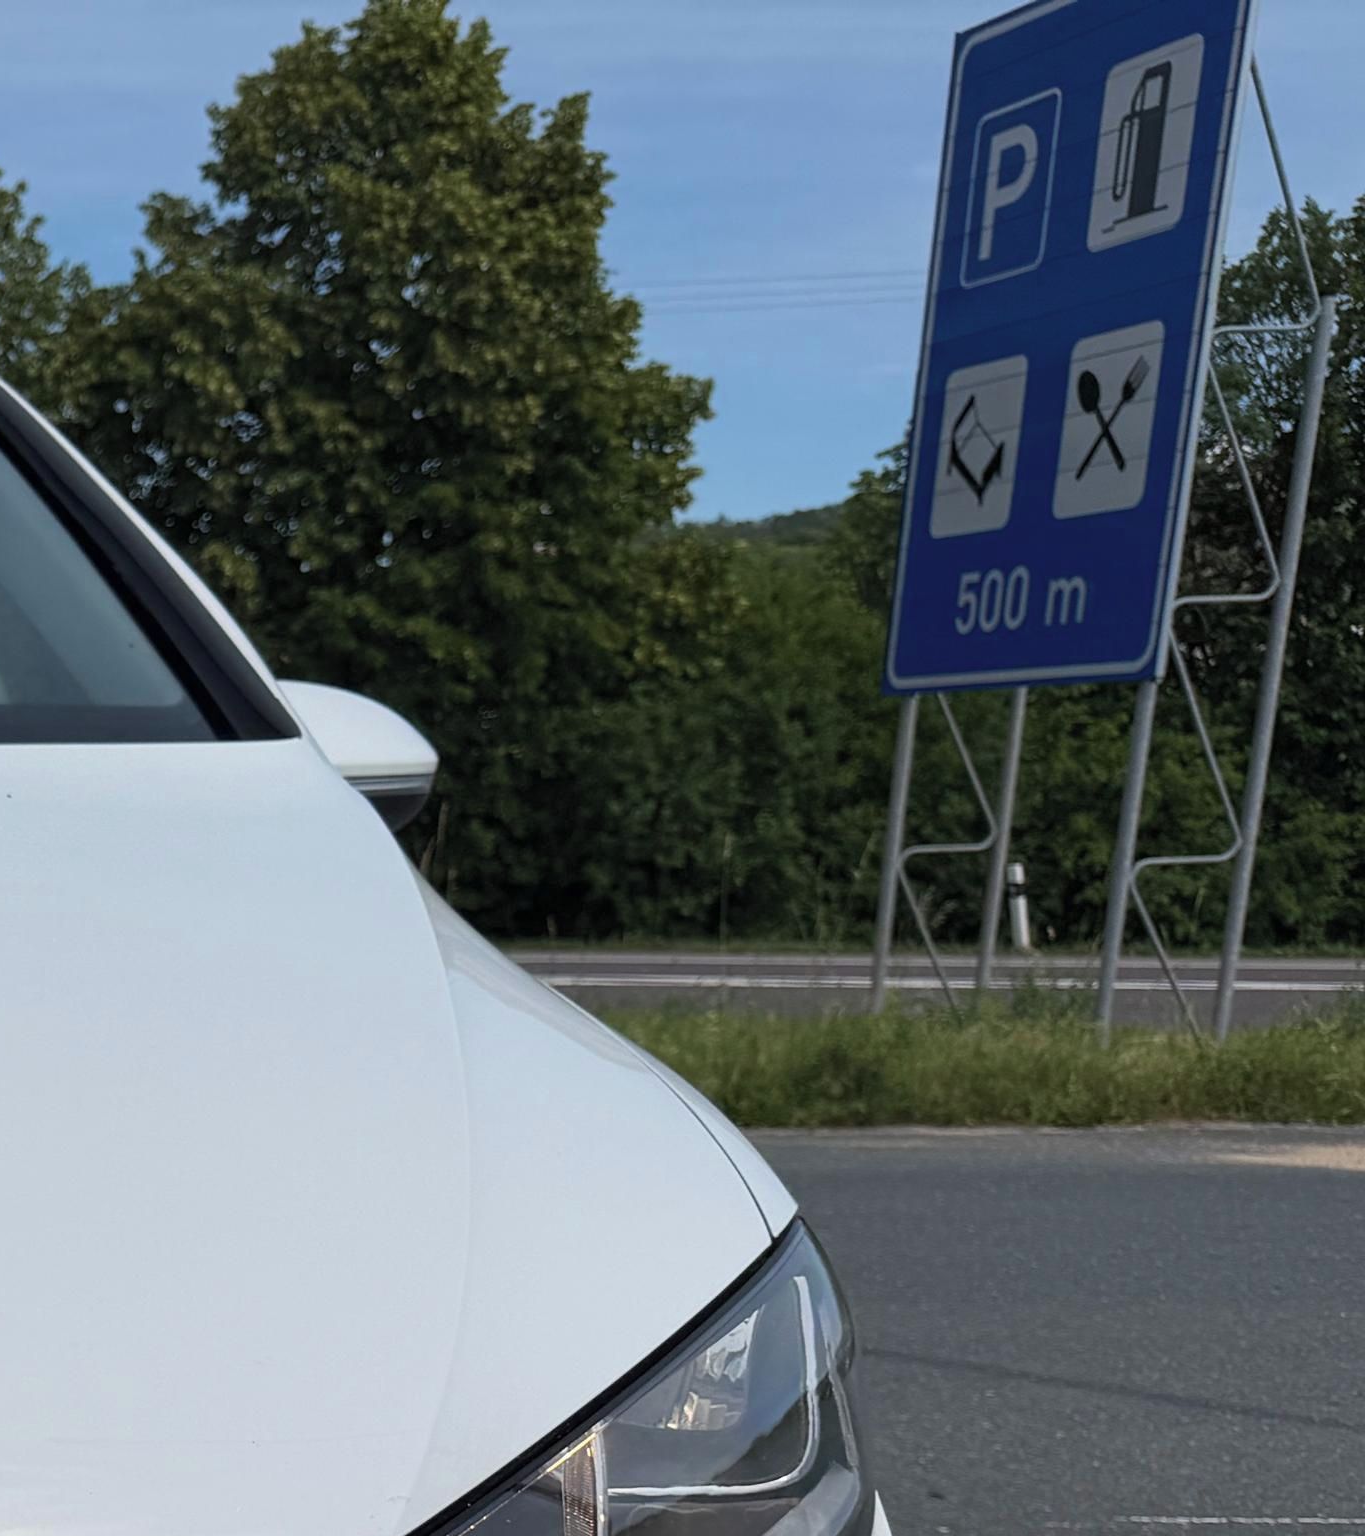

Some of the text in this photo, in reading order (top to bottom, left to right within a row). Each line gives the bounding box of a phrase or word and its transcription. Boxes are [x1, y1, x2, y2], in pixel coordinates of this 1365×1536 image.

[977, 123, 1039, 261] P
[954, 564, 1087, 635] 500 m
